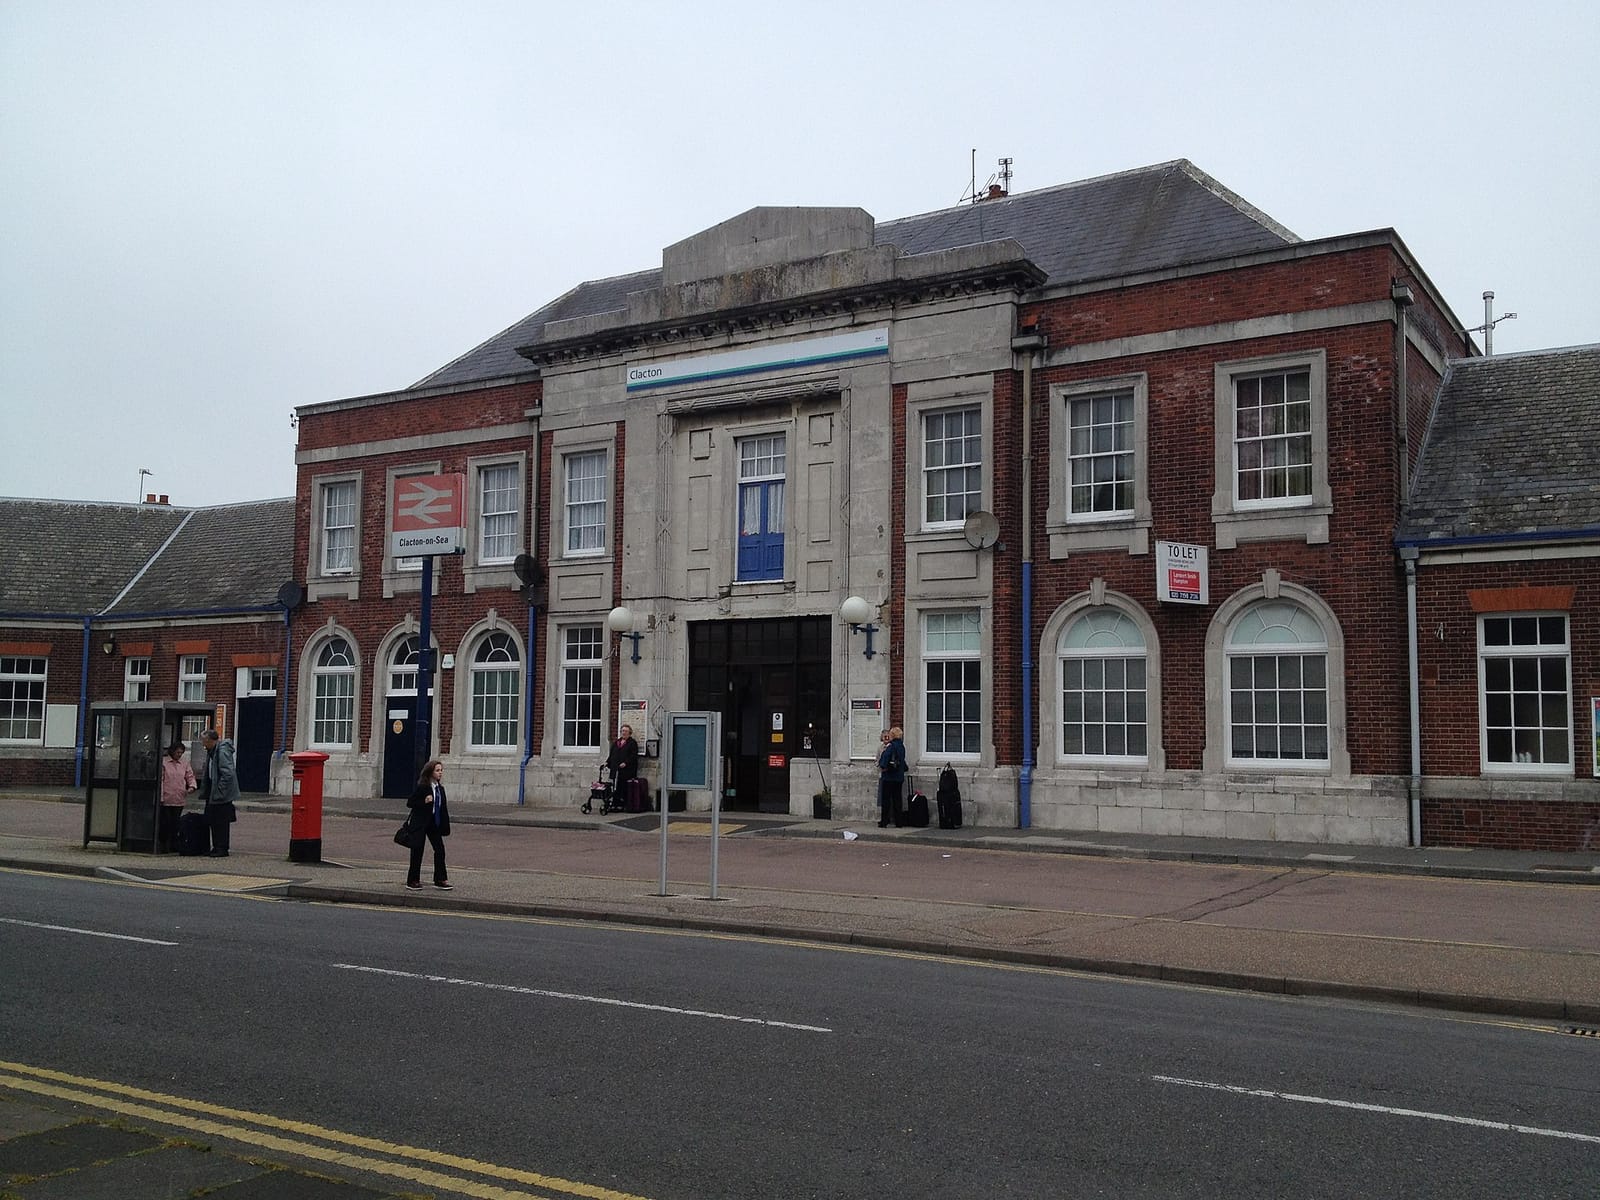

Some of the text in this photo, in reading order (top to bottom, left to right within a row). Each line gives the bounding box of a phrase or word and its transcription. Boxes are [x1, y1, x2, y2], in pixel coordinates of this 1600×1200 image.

[629, 368, 662, 380] Clacton
[399, 535, 449, 547] Clacton-on-Sea
[1167, 545, 1199, 559] TO LET
